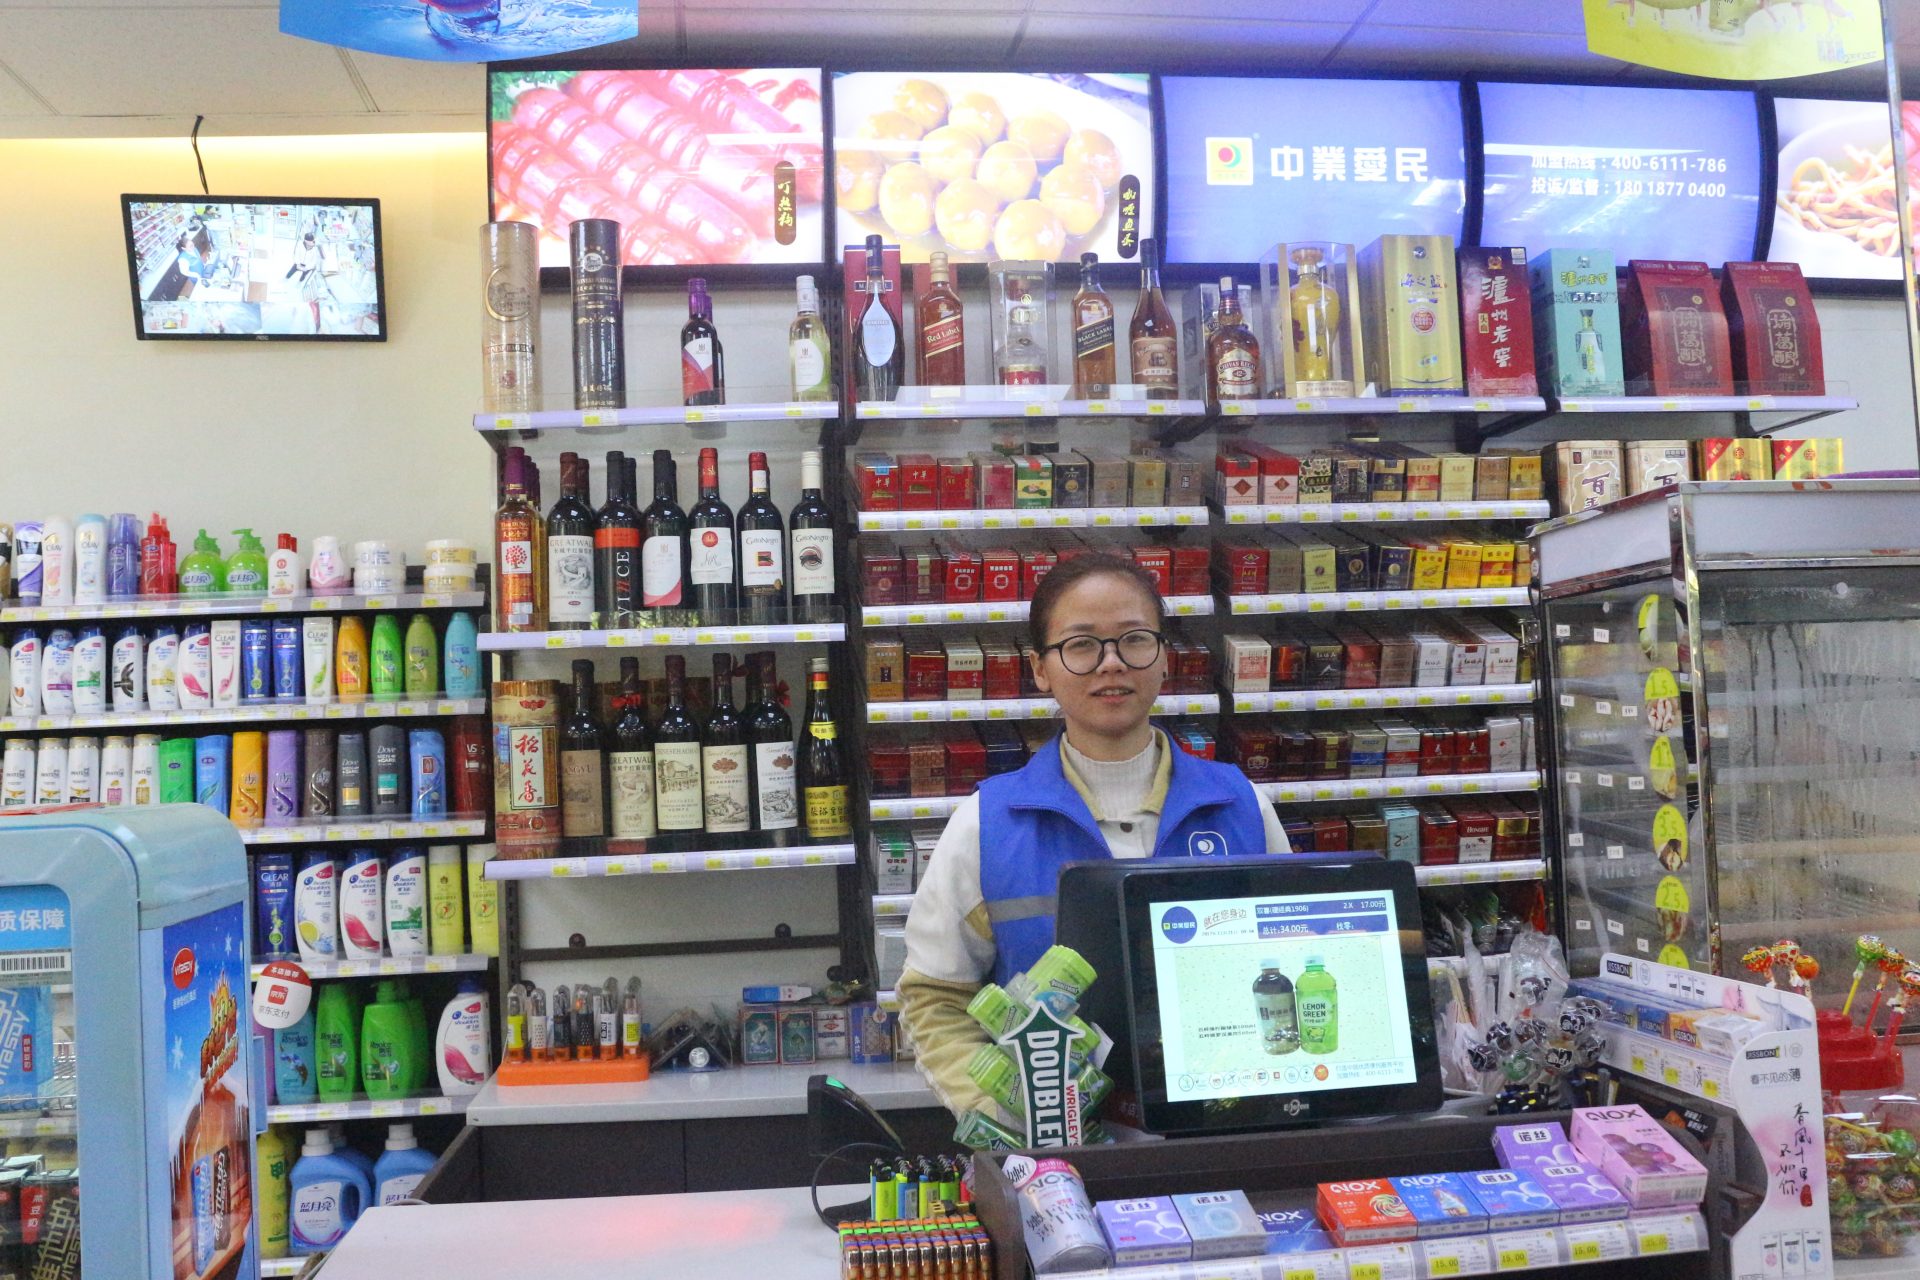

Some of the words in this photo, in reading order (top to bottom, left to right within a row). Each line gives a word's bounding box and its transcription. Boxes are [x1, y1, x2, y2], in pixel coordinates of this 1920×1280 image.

[1611, 155, 1727, 172] 400-6111-786
[1615, 180, 1642, 196] 180
[1648, 181, 1683, 196] 1877
[1688, 182, 1726, 198] 0400
[926, 331, 941, 344] Red
[941, 325, 961, 341] Label
[550, 538, 594, 547] GREATWAL
[307, 631, 328, 639] CLEAR
[377, 745, 397, 754] Dove
[342, 759, 359, 767] Dove
[261, 872, 289, 882] CLEAR
[1607, 961, 1631, 978] JISSBON
[1302, 1003, 1326, 1011] LEMON
[1303, 1010, 1326, 1018] GREEN
[1748, 1050, 1775, 1060] JISSBON
[1751, 1068, 1801, 1085] 看不见的薄
[1330, 1181, 1381, 1194] NOX
[300, 1200, 333, 1213] 蓝月亮
[1502, 1253, 1525, 1263] 15.00
[1435, 1260, 1459, 1269] 15.00
[1355, 1267, 1380, 1277] 15.00
